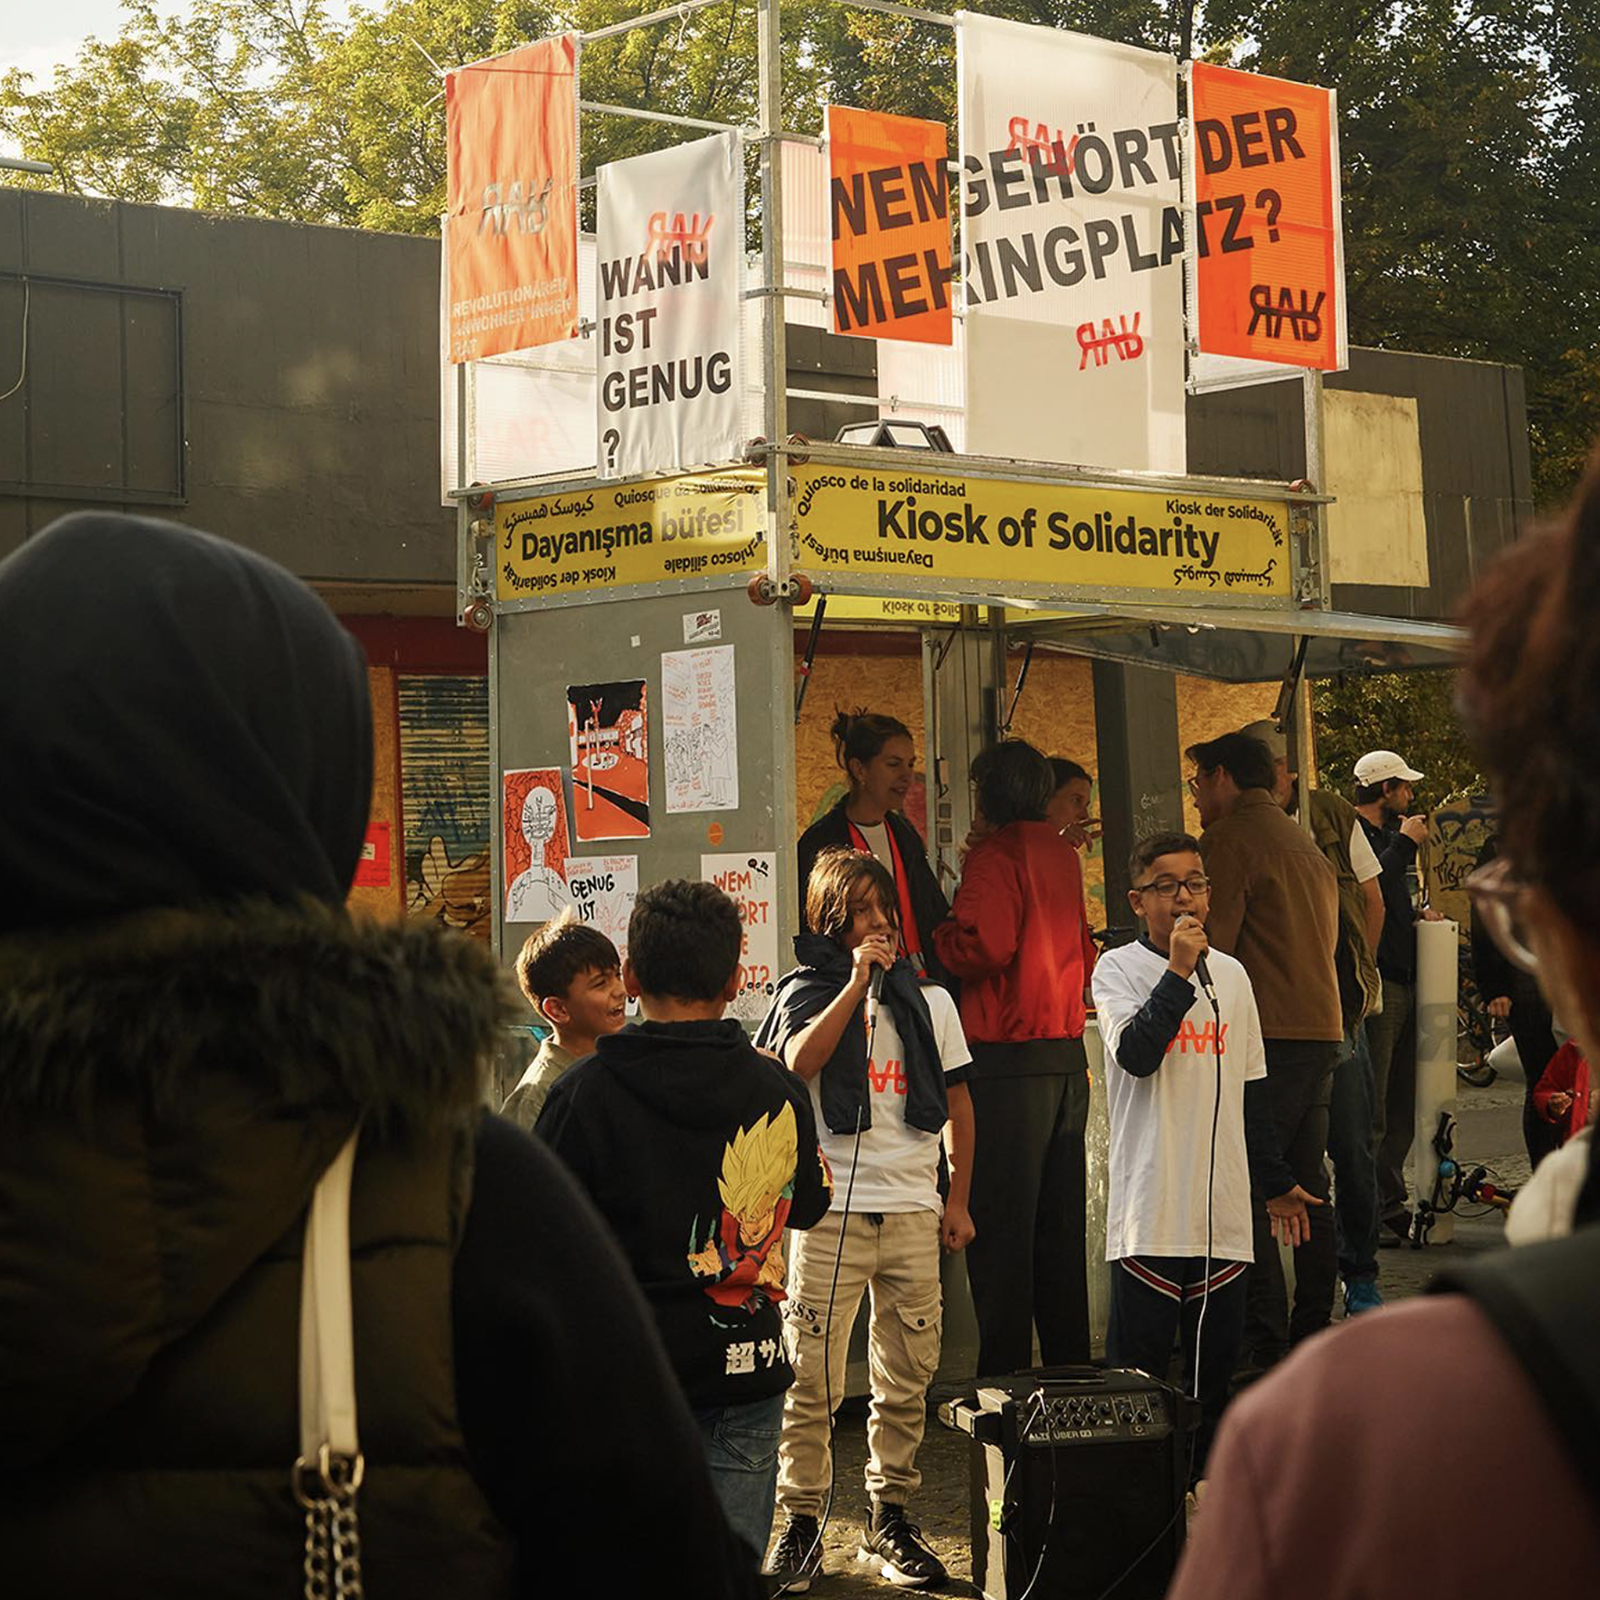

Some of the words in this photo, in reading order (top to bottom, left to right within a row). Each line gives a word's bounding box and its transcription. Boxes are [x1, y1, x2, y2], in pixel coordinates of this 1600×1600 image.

[1196, 107, 1306, 175] DER
[601, 240, 709, 301] WANN
[603, 307, 657, 357] IST
[602, 352, 731, 412] GENUG
[603, 428, 620, 468] ?
[798, 475, 846, 517] Quiosco
[850, 475, 868, 490] de
[873, 477, 885, 491] la
[889, 478, 966, 497] solidaridad
[522, 522, 652, 564] Dayanışma
[661, 499, 743, 542] büfesi
[878, 496, 989, 545] Kiosk
[998, 508, 1037, 547] of
[1048, 511, 1220, 568] Solidarity
[1166, 499, 1202, 515] Kiosk
[1205, 503, 1225, 517] der
[1228, 505, 1283, 547] Solidarität
[802, 533, 849, 564] büfesi
[853, 547, 933, 568] Dayanışma
[503, 561, 557, 590] Solidarität
[560, 571, 579, 585] der
[583, 566, 616, 582] Kiosk
[570, 873, 615, 899] GENUG
[713, 870, 751, 892] WEM
[578, 900, 595, 921] IST
[735, 895, 768, 925] ÖRT
